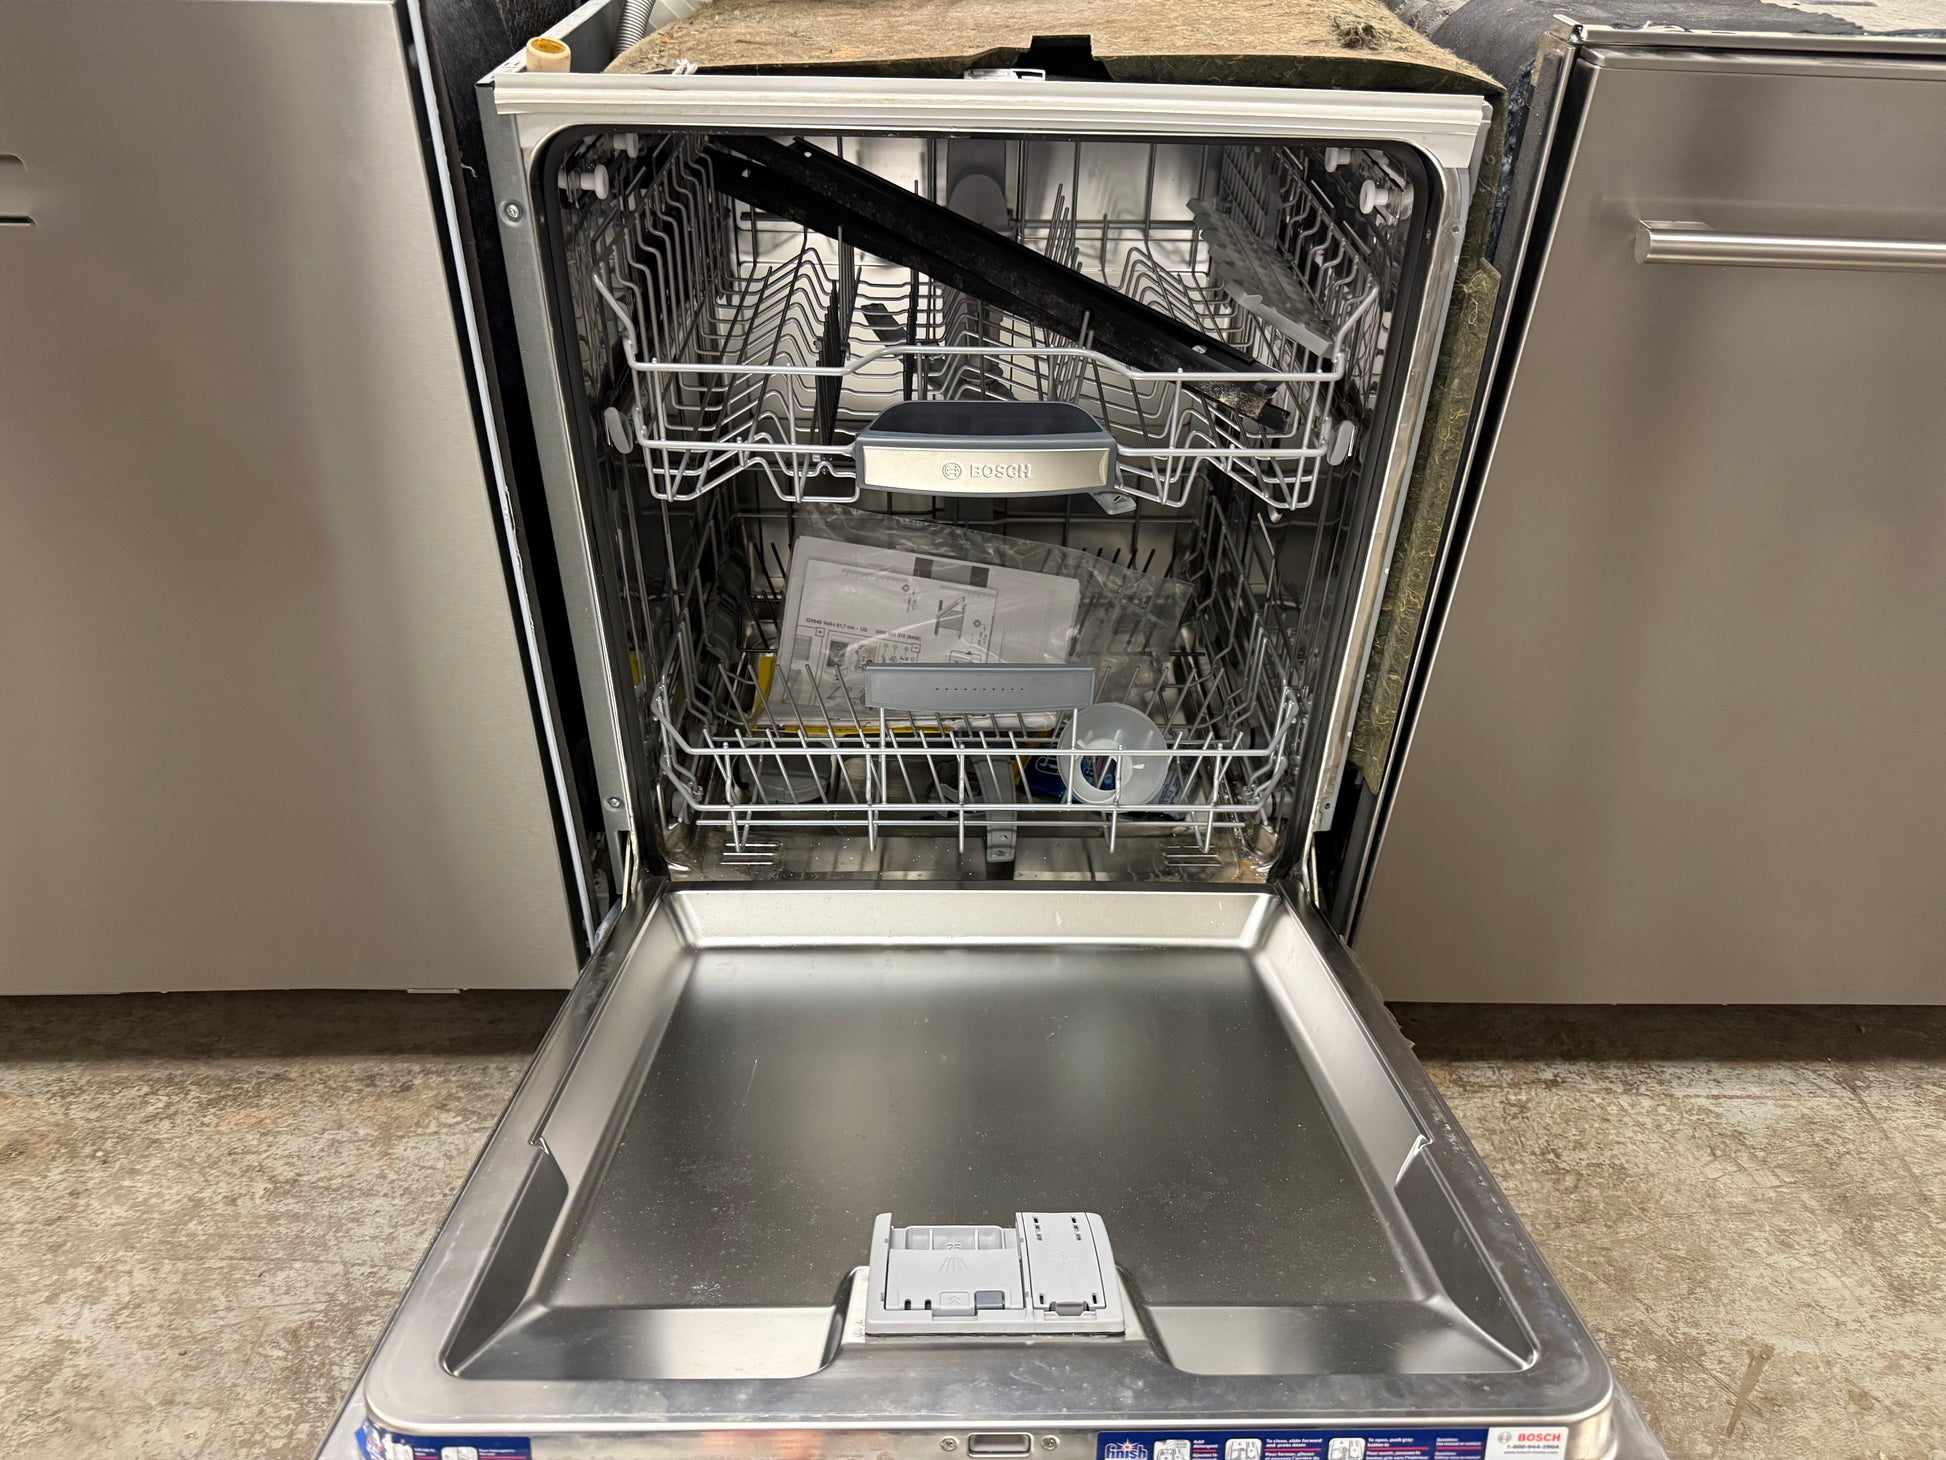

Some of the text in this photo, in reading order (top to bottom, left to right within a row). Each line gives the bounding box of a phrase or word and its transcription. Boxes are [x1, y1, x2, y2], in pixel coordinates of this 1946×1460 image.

[970, 464, 1031, 478] BOSCH
[1518, 1433, 1561, 1441] BOSCH
[1105, 1442, 1147, 1458] finish
